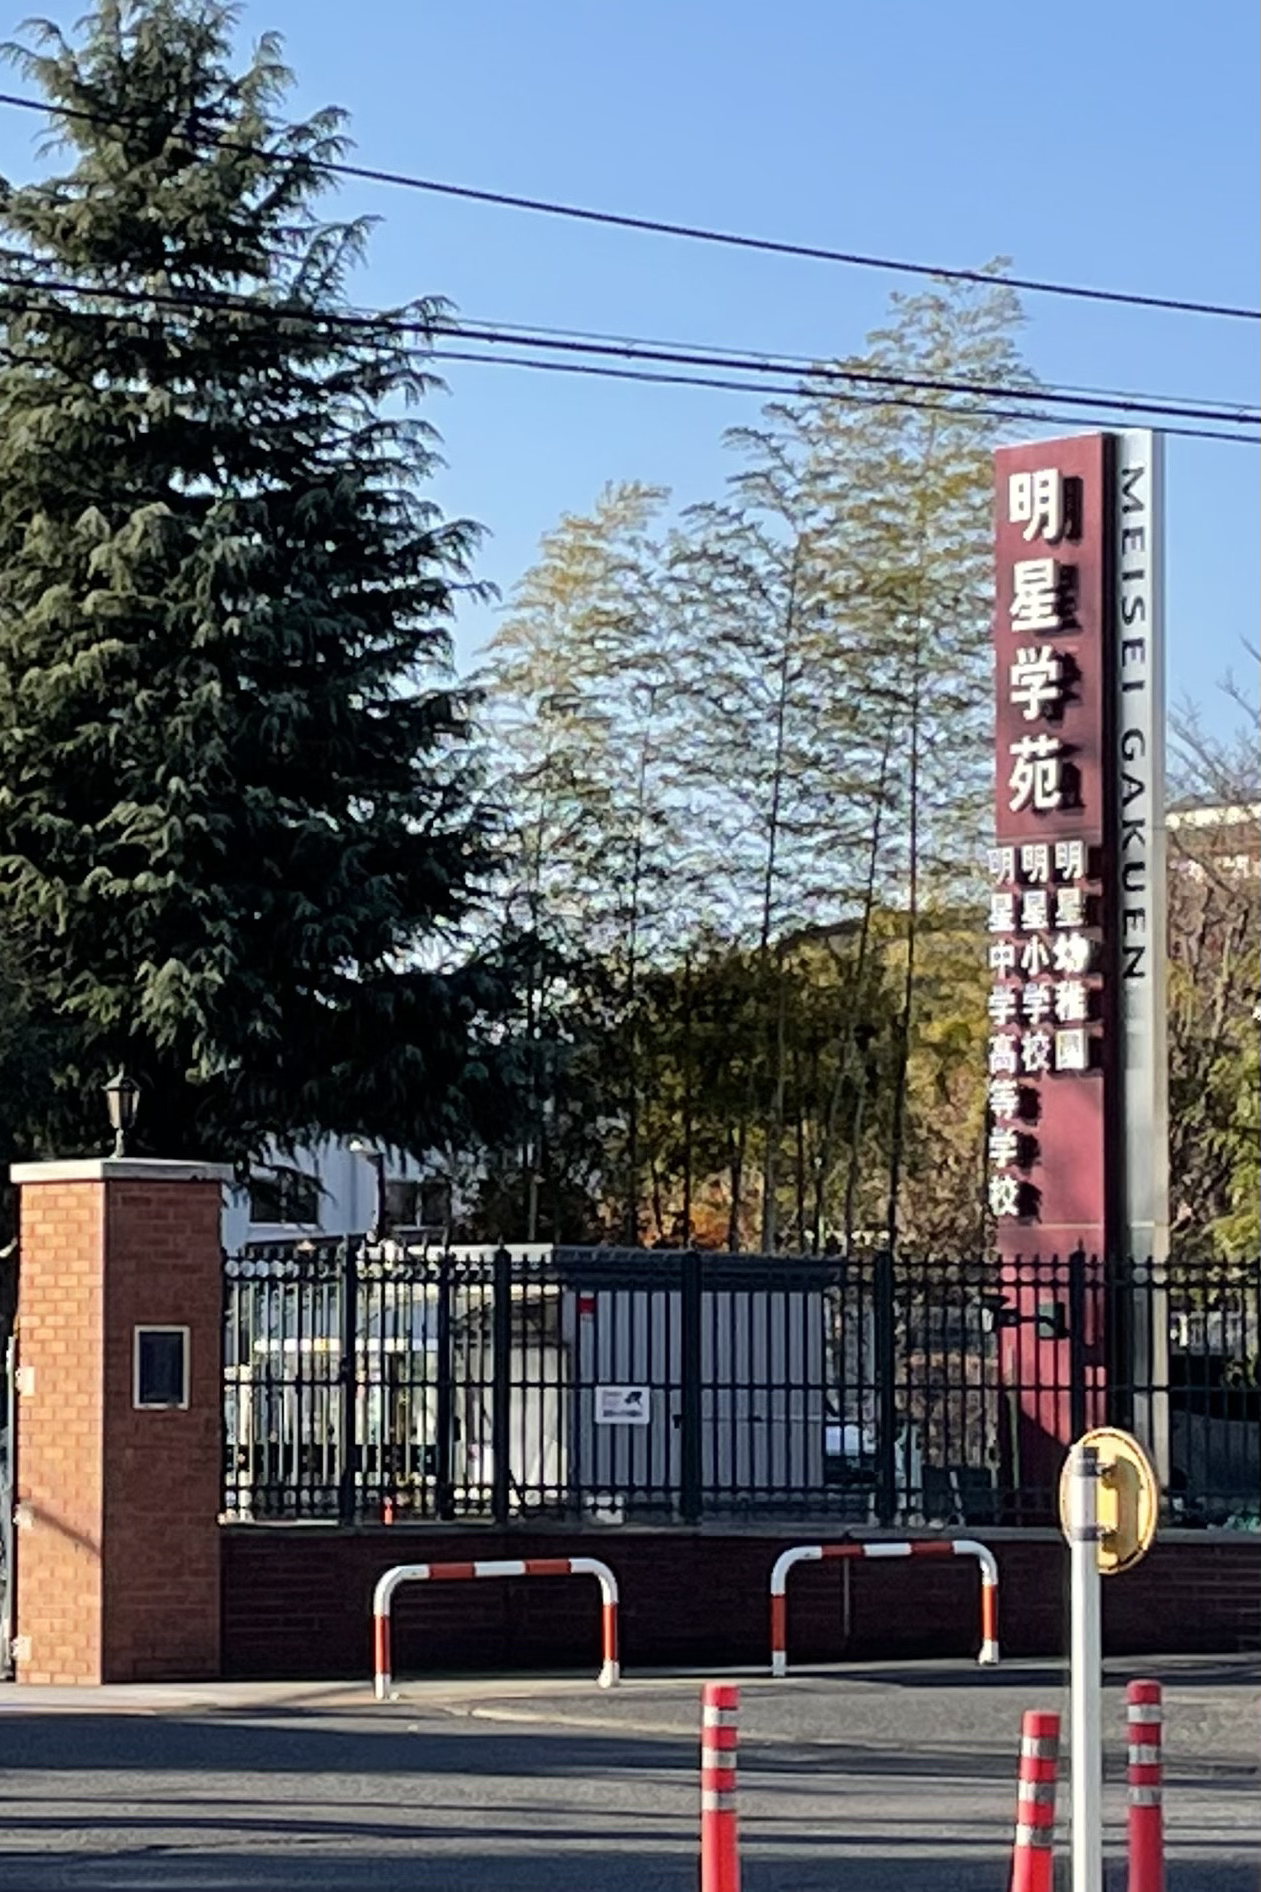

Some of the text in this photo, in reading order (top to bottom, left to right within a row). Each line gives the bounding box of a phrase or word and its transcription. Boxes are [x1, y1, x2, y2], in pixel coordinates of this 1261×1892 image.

[1008, 467, 1063, 812] 明星学苑
[1121, 464, 1146, 979] MEISEI GAKUEN
[987, 846, 1020, 1217] 明星中学高等学校
[1020, 843, 1051, 1072] 明星小学校
